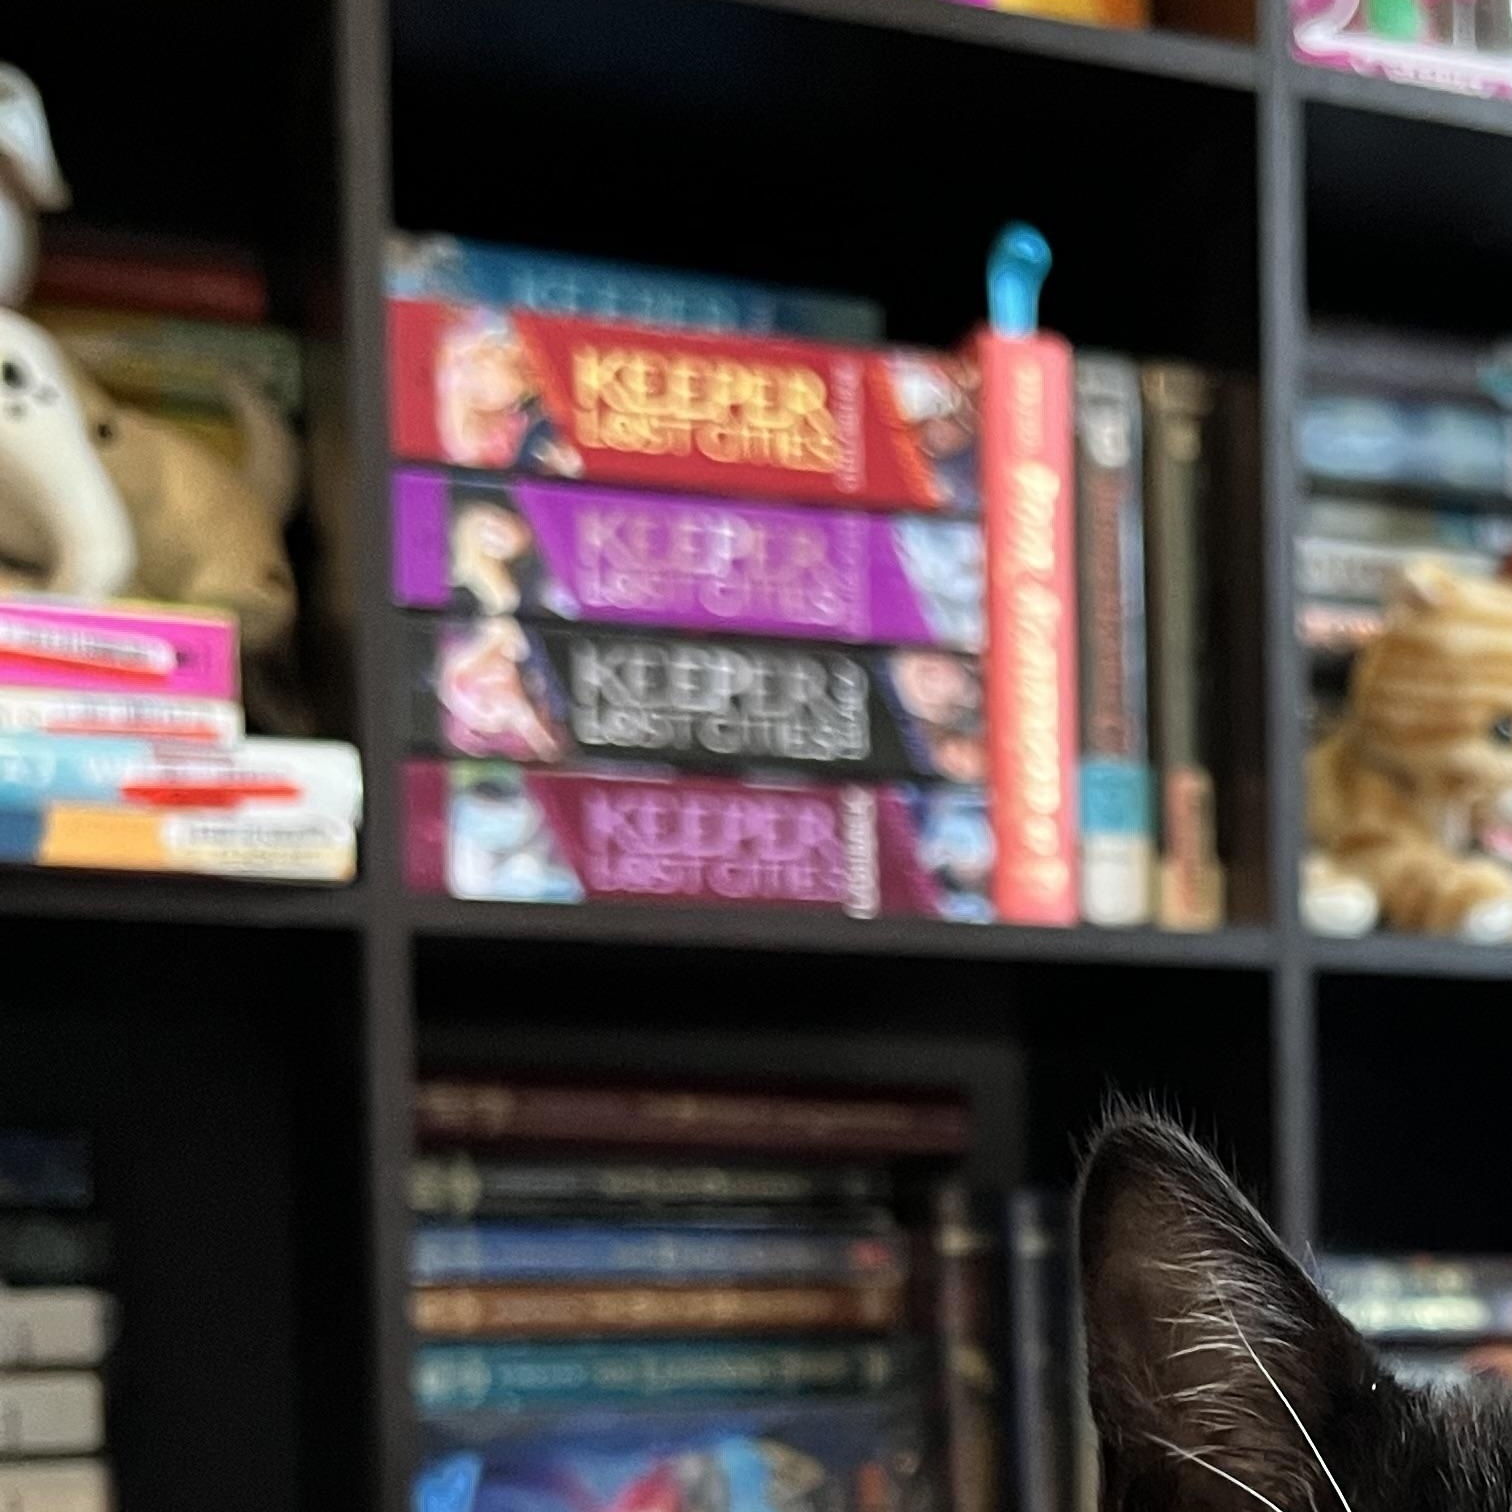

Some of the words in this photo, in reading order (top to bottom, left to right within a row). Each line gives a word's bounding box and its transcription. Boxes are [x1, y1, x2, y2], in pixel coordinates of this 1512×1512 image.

[572, 346, 836, 436] KEEPER
[574, 408, 694, 456] LOST
[696, 422, 840, 474] CITIES
[577, 509, 838, 594] KEEPER
[570, 638, 836, 728] KEEPER
[572, 706, 692, 749] LOST
[583, 789, 845, 876] KEEPER
[585, 854, 703, 893] LOST
